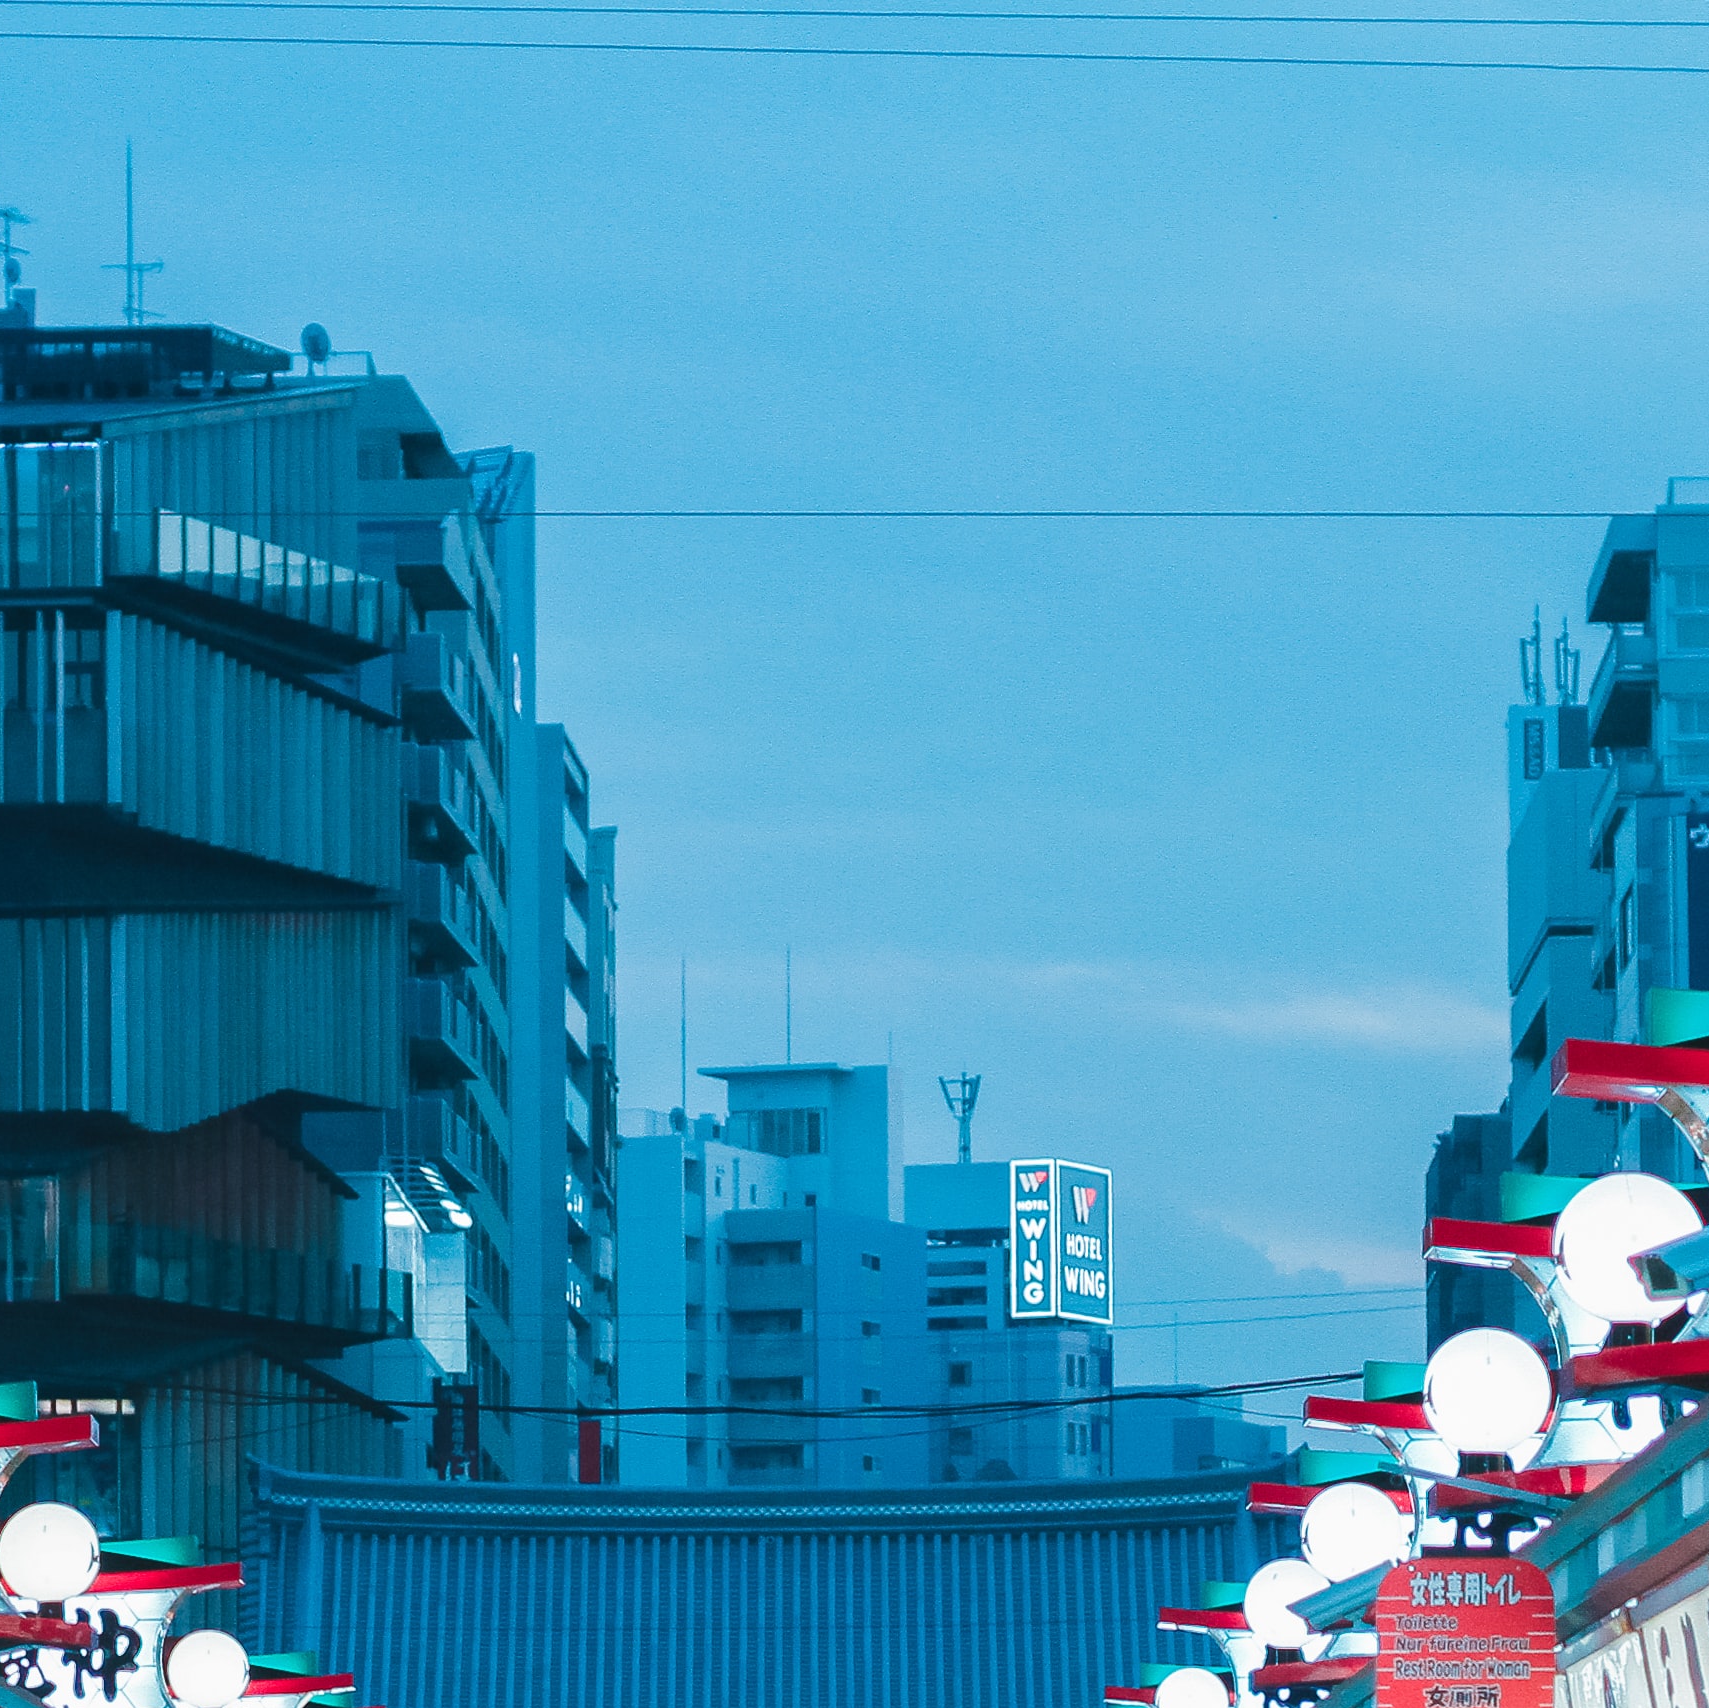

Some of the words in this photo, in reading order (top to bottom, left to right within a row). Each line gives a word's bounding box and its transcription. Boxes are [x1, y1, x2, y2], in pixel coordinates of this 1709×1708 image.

[1017, 1200, 1049, 1212] HOTEL
[1066, 1233, 1102, 1261] HOTEL
[1020, 1218, 1046, 1304] WING
[1064, 1266, 1105, 1299] WING
[1410, 1571, 1522, 1607] 女性専用トイレ
[1396, 1615, 1458, 1630] Toilette
[1396, 1637, 1423, 1651] Nur
[1490, 1637, 1530, 1651] Frau
[1462, 1659, 1482, 1678] for
